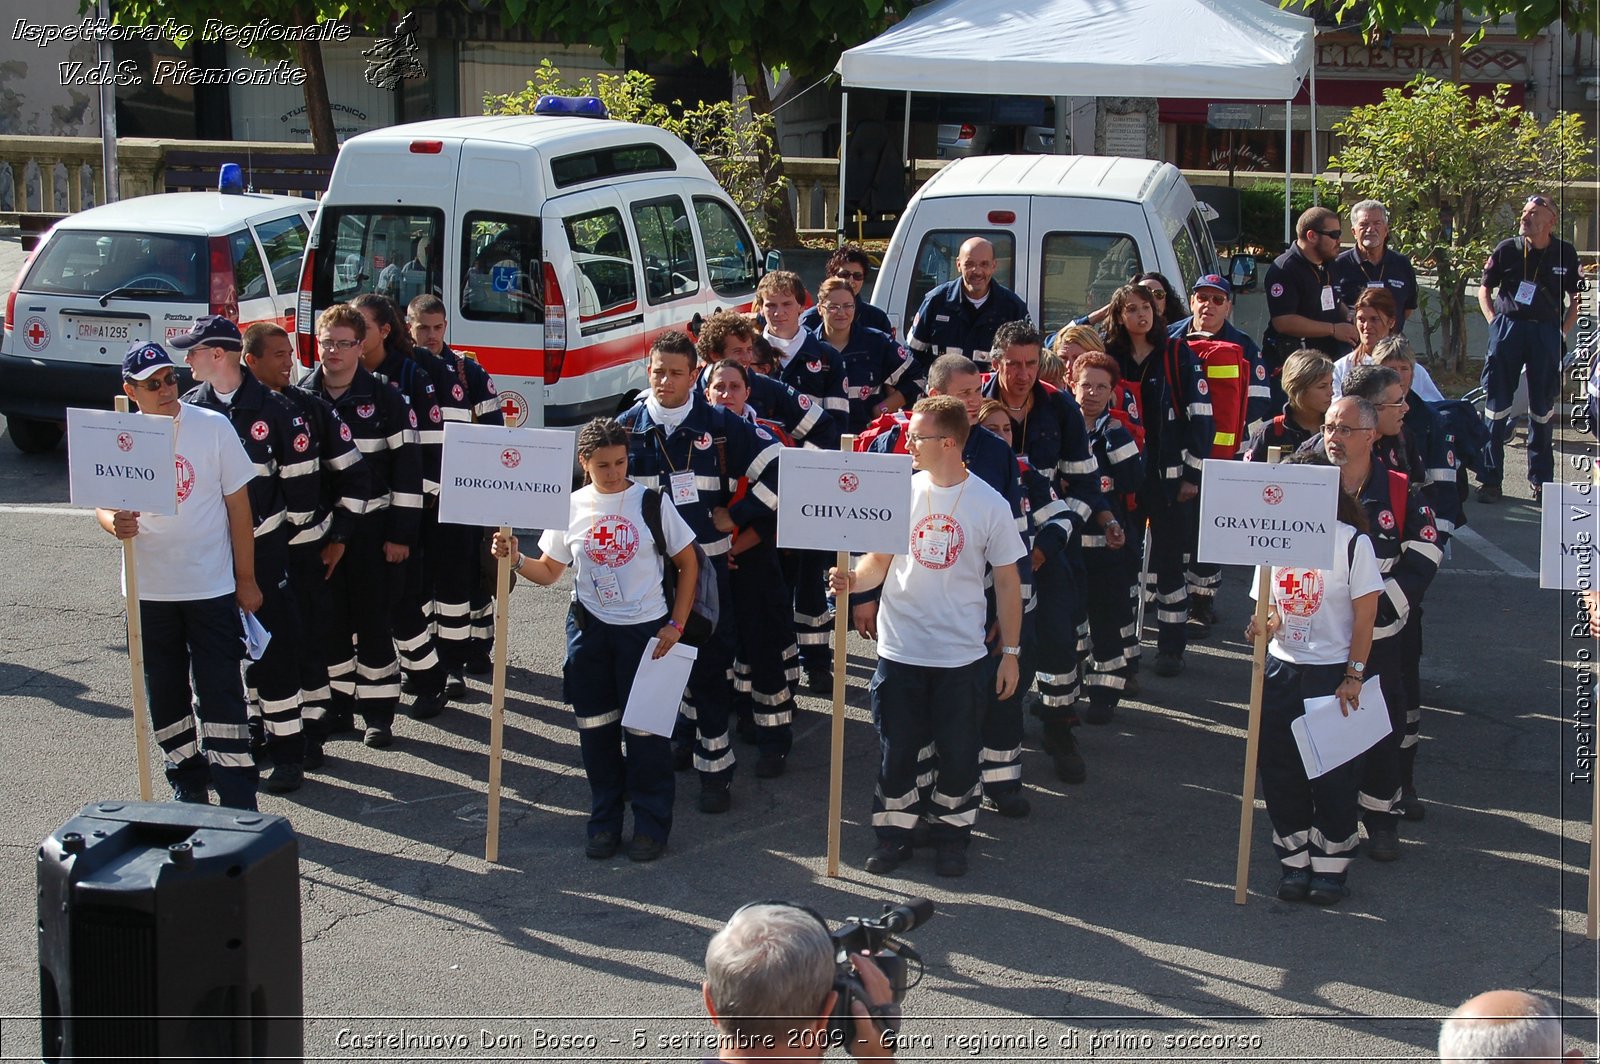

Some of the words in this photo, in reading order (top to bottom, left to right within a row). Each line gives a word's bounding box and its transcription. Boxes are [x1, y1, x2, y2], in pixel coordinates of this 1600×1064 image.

[280, 105, 308, 122] STUD
[95, 463, 155, 481] BAVENO
[455, 477, 561, 494] BORGOMANERO
[801, 503, 892, 521] CHIVASSO
[1214, 515, 1326, 533] GRAVELLONA
[1248, 535, 1291, 549] TOCE
